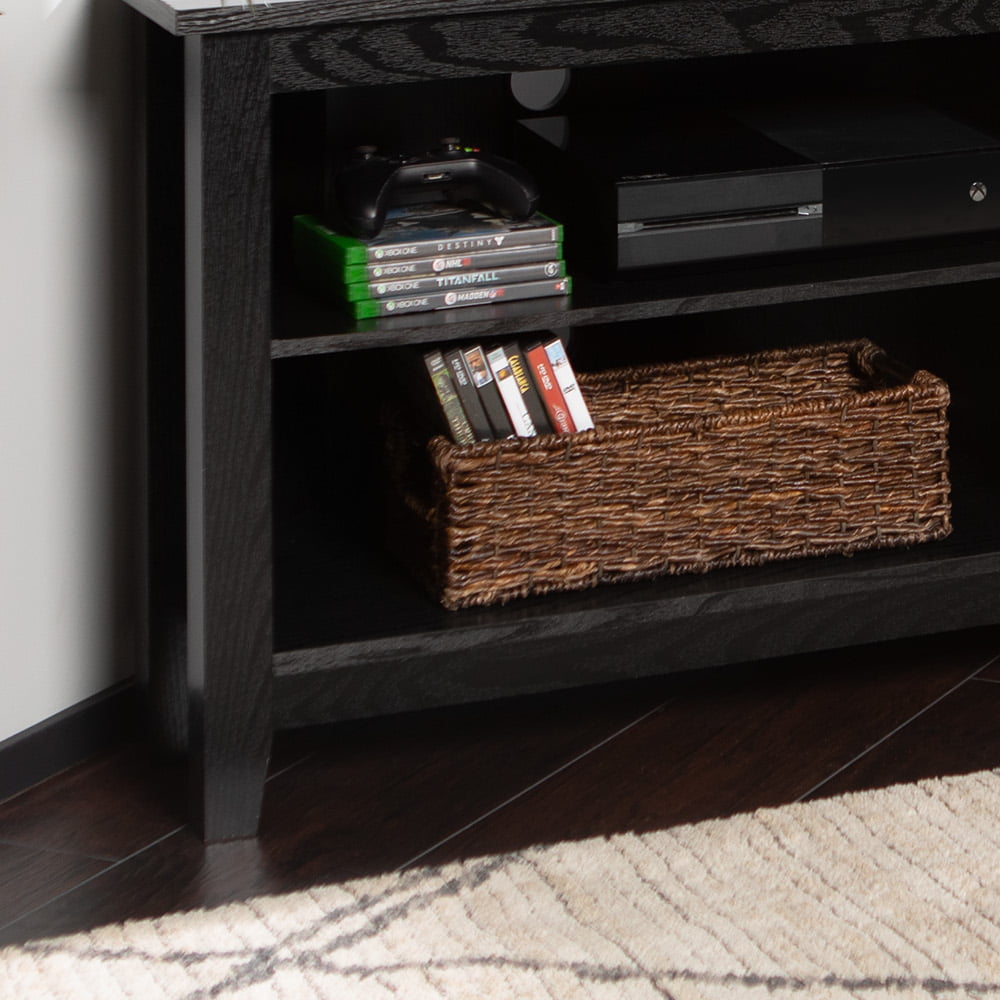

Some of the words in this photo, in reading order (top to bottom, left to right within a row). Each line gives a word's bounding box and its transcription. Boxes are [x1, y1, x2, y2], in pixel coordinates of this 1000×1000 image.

[437, 239, 492, 251] DESTINY
[436, 272, 499, 287] TITANFALL
[508, 355, 530, 394] CASABLANCA
